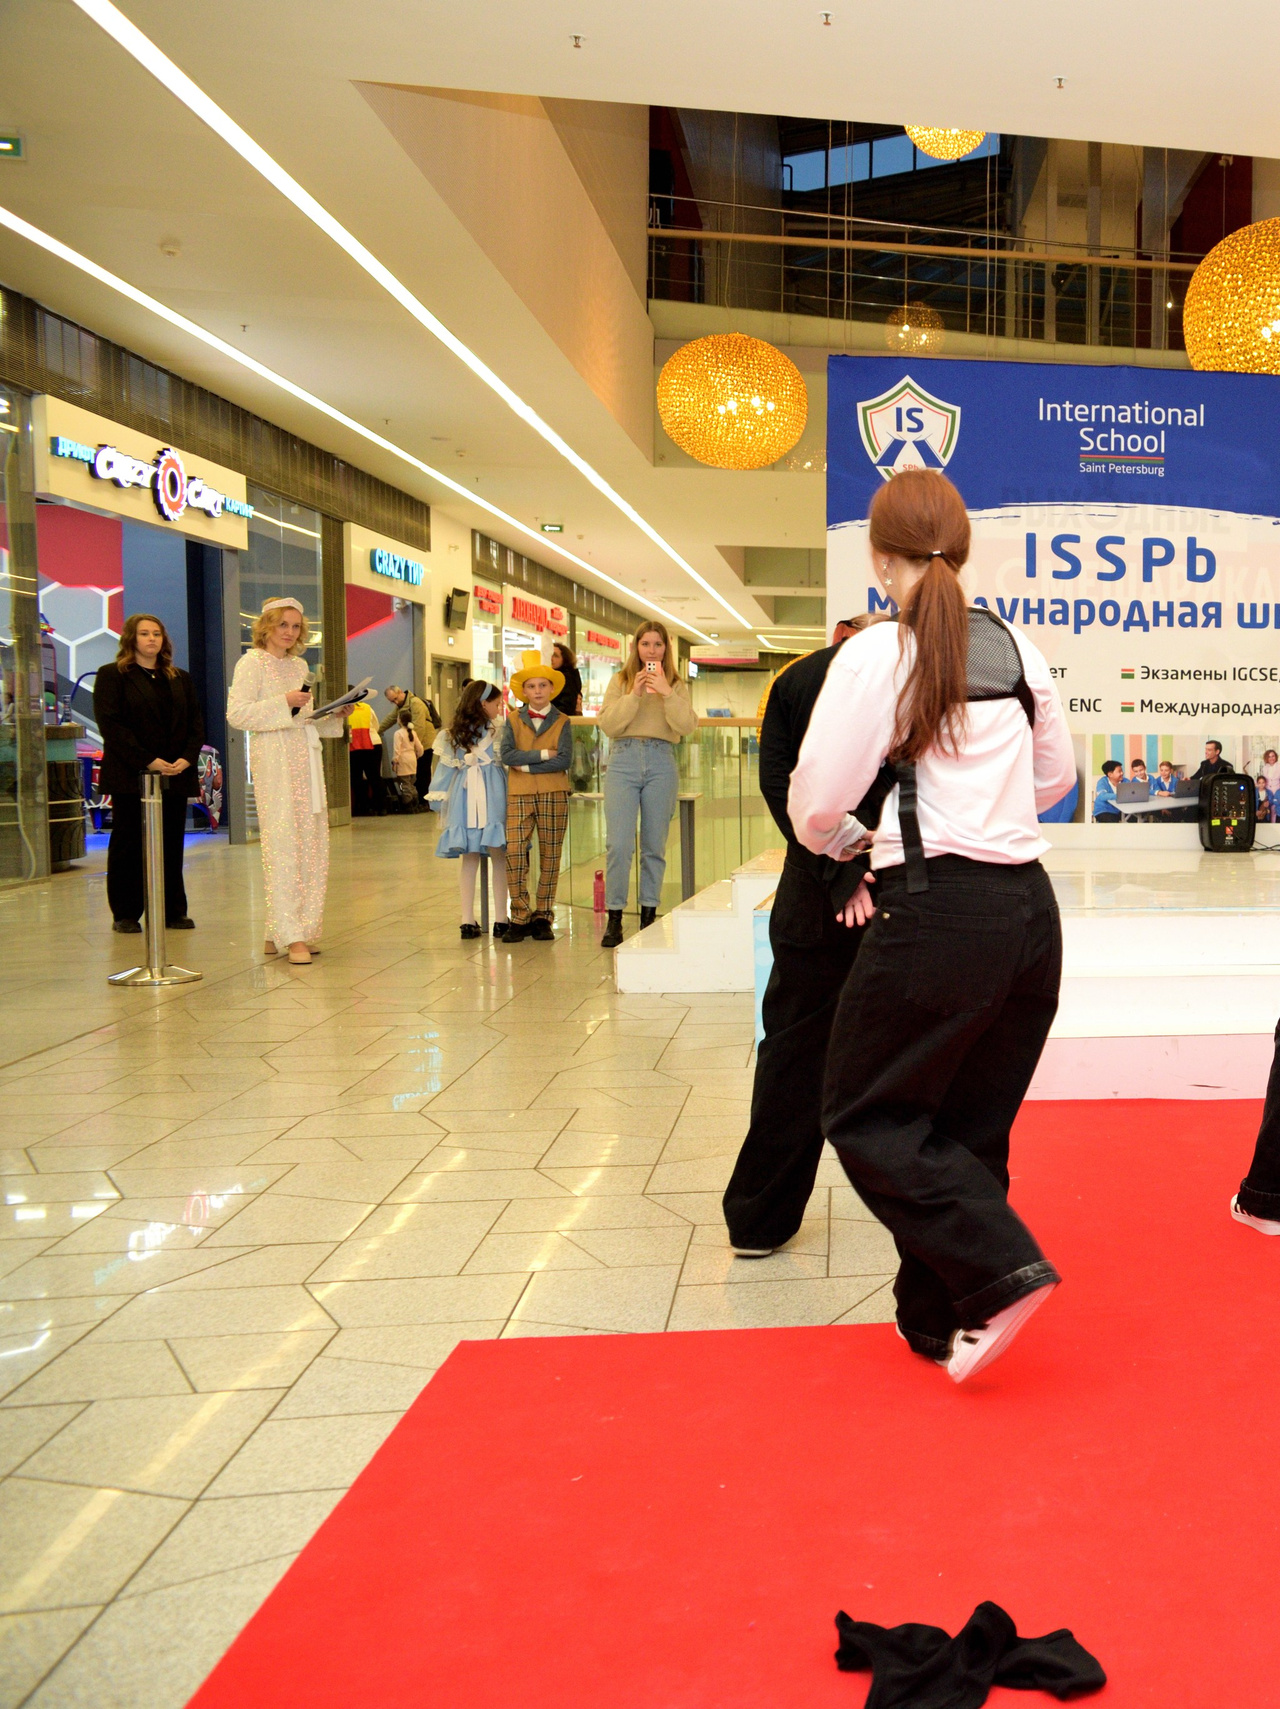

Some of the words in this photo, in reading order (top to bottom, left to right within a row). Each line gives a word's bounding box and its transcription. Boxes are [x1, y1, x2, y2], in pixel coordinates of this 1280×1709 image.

[895, 407, 924, 433] IS
[1039, 397, 1204, 427] International
[1079, 427, 1165, 454] School
[1079, 462, 1106, 473] Saint
[1108, 463, 1165, 478] Petersburg
[375, 548, 406, 580] CRAZY
[406, 559, 424, 586] ТИР
[1025, 532, 1217, 583] ISSPb
[867, 587, 1223, 635] Мународная
[1140, 666, 1227, 681] Экзамены
[1069, 698, 1102, 713] ENC
